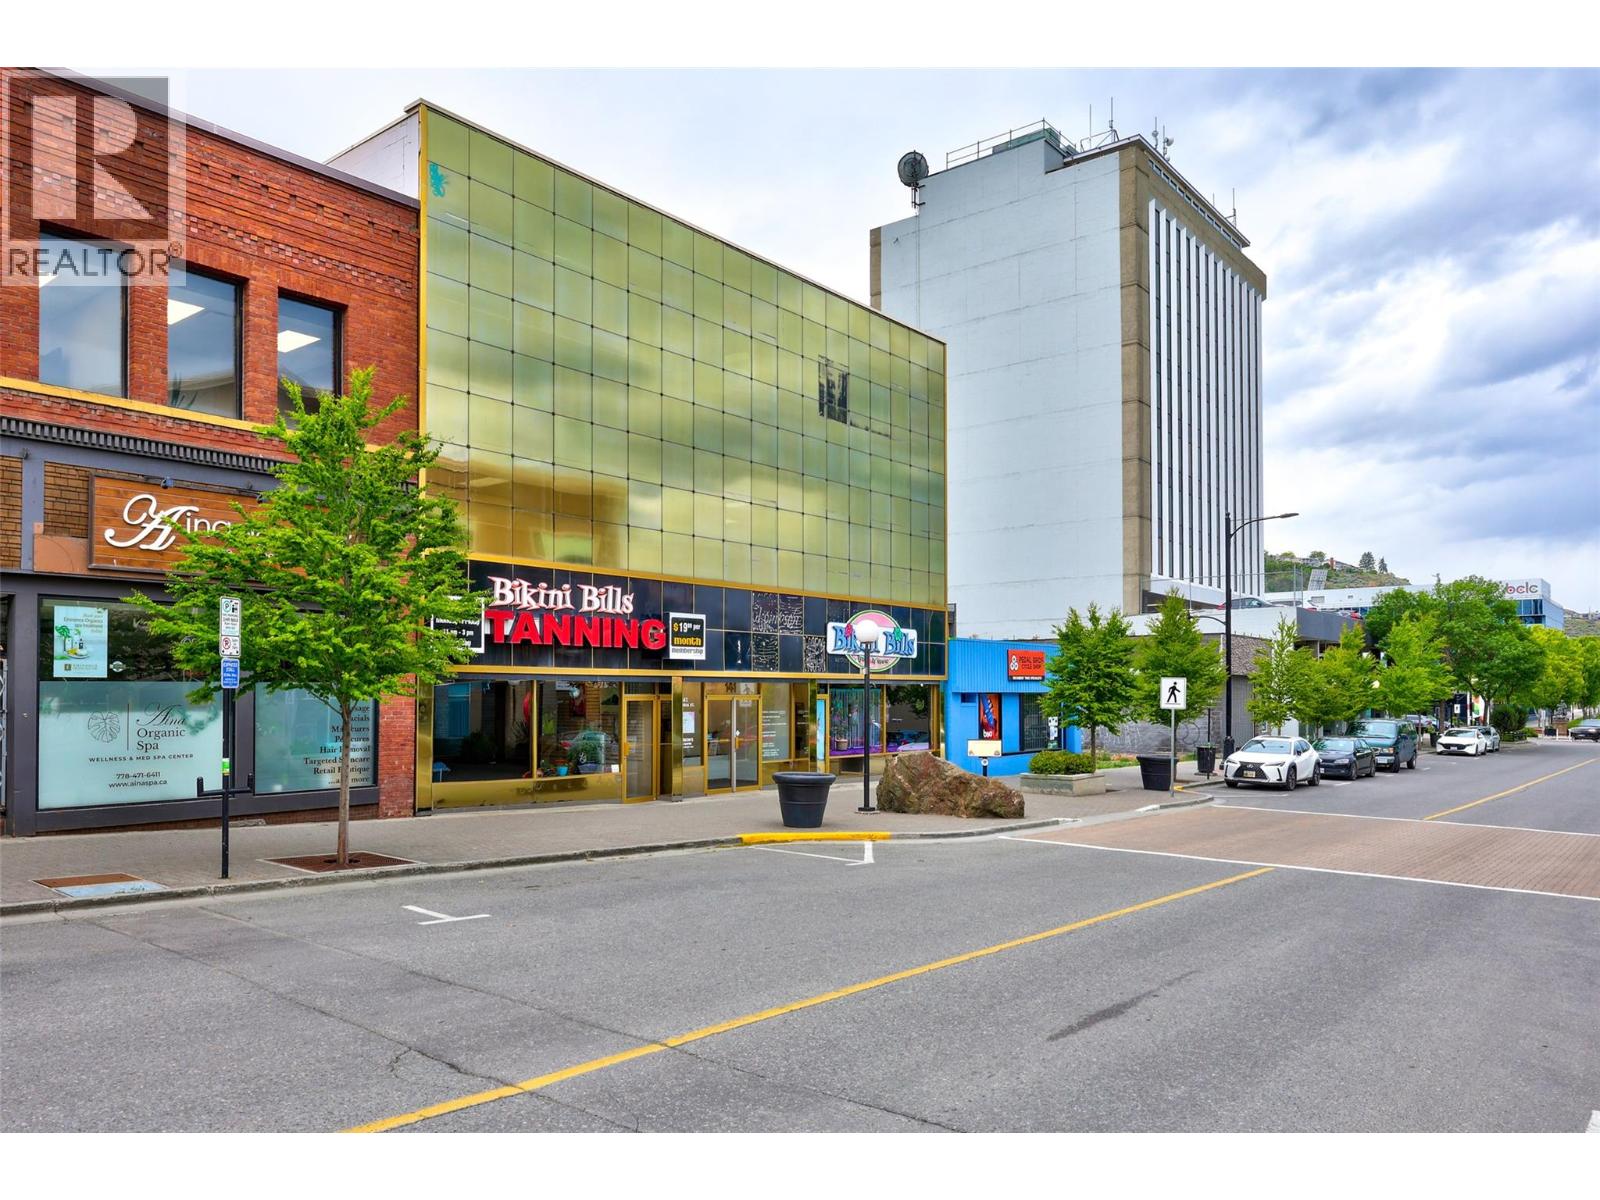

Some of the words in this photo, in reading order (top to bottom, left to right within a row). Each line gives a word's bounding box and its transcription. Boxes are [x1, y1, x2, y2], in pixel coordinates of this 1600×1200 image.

[1505, 582, 1538, 594] bclc
[488, 576, 575, 610] Bikini
[577, 584, 635, 614] Bills
[485, 609, 666, 650] TANNING
[674, 636, 702, 646] month
[136, 702, 186, 726] Aina
[136, 727, 186, 741] Organic
[136, 740, 159, 752] Spa
[320, 746, 338, 754] Hair
[304, 756, 338, 766] Targeted
[116, 772, 161, 780] 778-471-6411
[313, 766, 336, 775] Retail
[108, 780, 168, 789] www.ainaspa.ca
